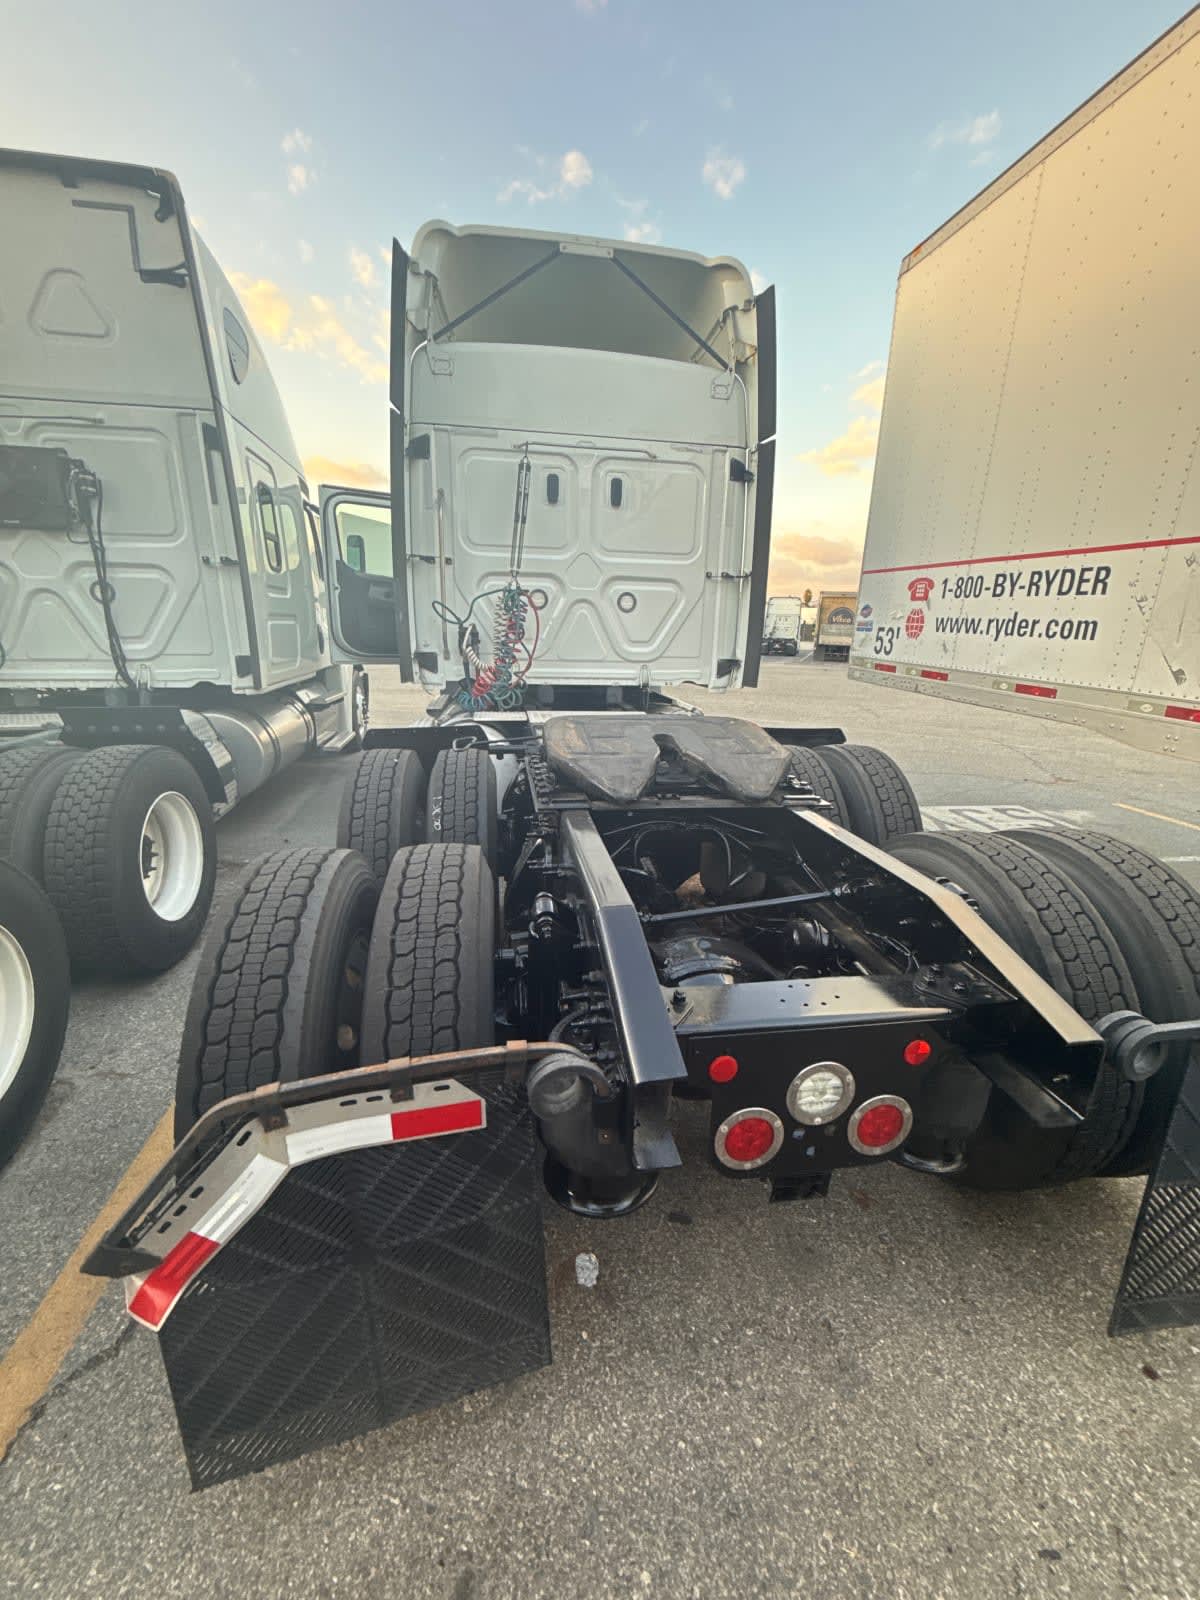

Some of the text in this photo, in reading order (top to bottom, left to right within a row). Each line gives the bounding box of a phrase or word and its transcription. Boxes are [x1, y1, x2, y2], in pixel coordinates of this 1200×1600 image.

[941, 566, 1112, 599] 1-800-BY-RYDER
[874, 626, 901, 656] 53'
[935, 611, 1098, 641] www.ryder.com
